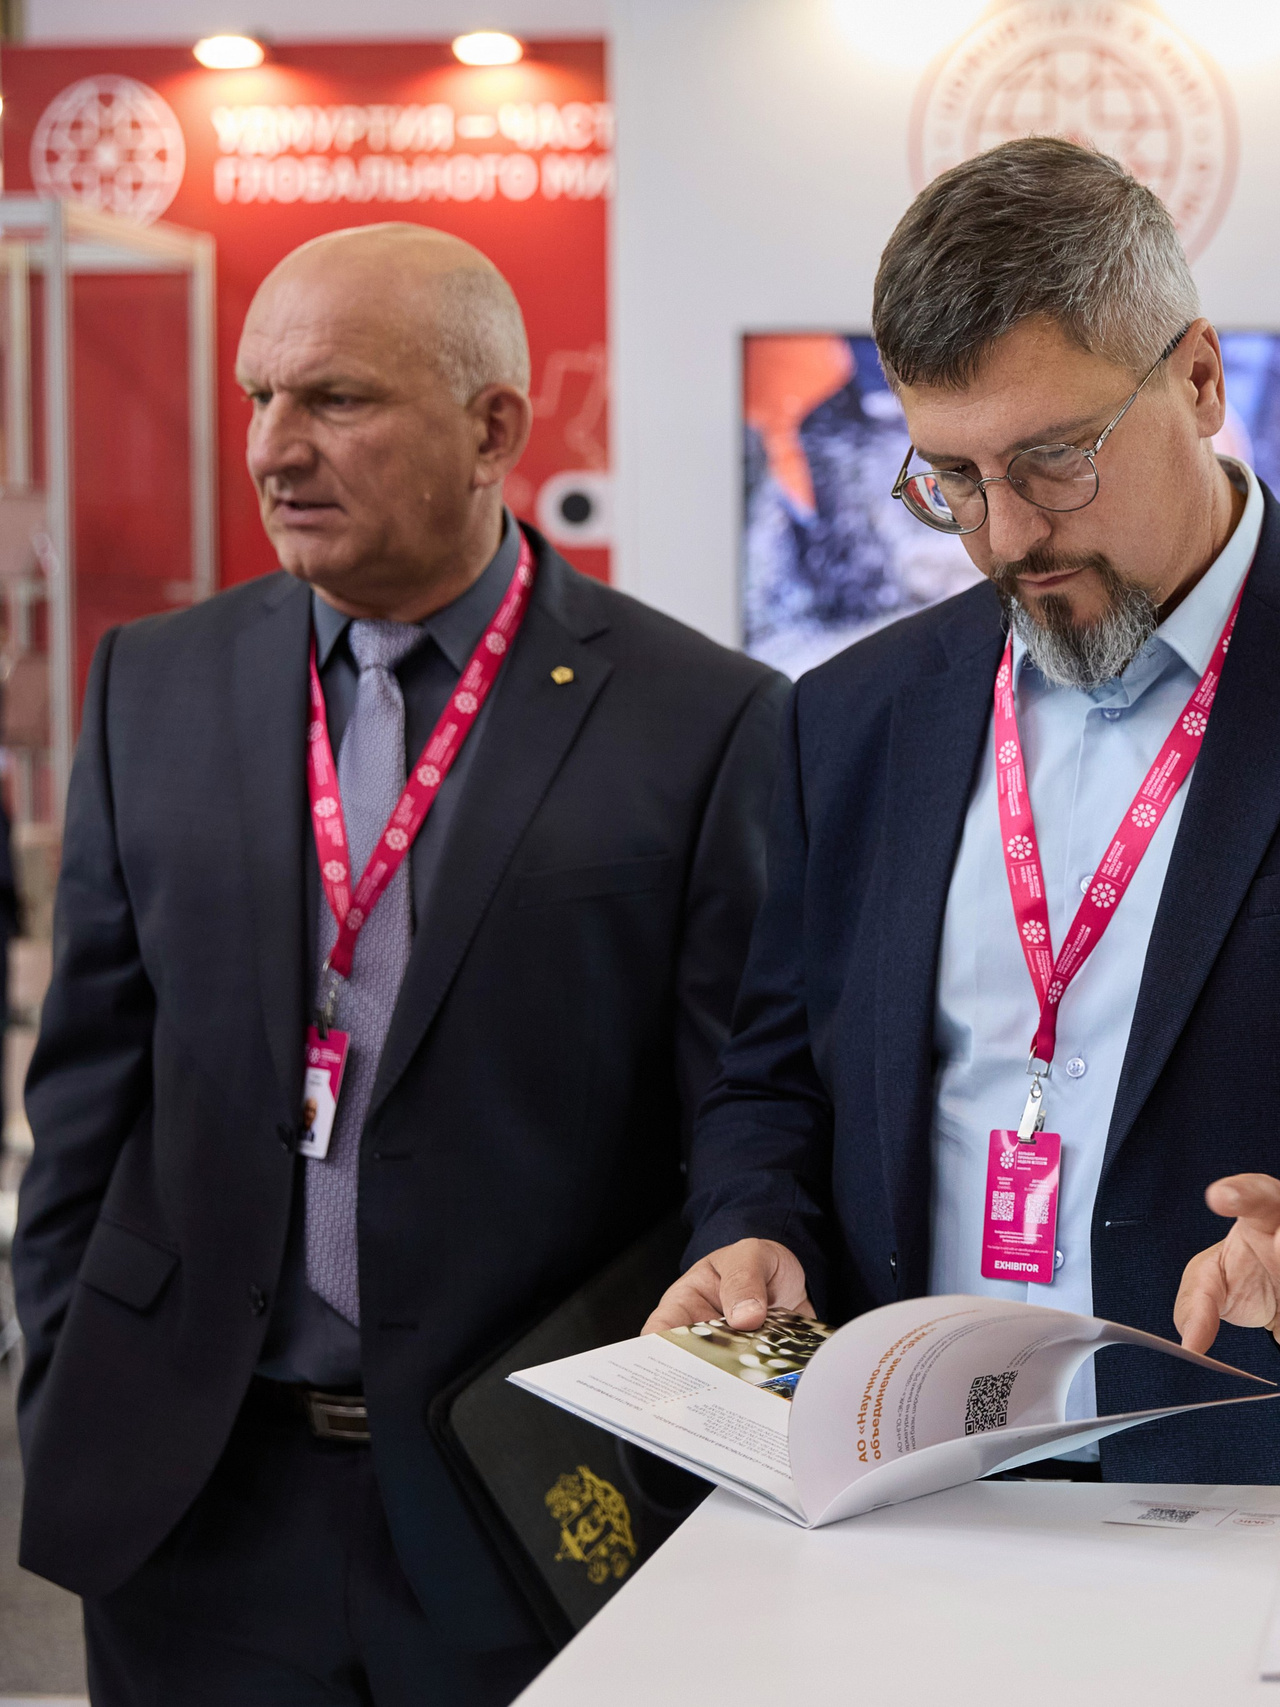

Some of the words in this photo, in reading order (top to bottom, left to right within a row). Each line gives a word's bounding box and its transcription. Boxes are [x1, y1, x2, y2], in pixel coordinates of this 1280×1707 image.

[212, 102, 455, 157] УДМУРТИЯ
[498, 102, 616, 152] ЧАСТ
[213, 153, 538, 204] ГЛОБАЛЬНОГО
[541, 152, 614, 201] МИ
[994, 1260, 1039, 1273] EXHIBITOR
[870, 1357, 901, 1460] объединение
[856, 1438, 869, 1463] АО
